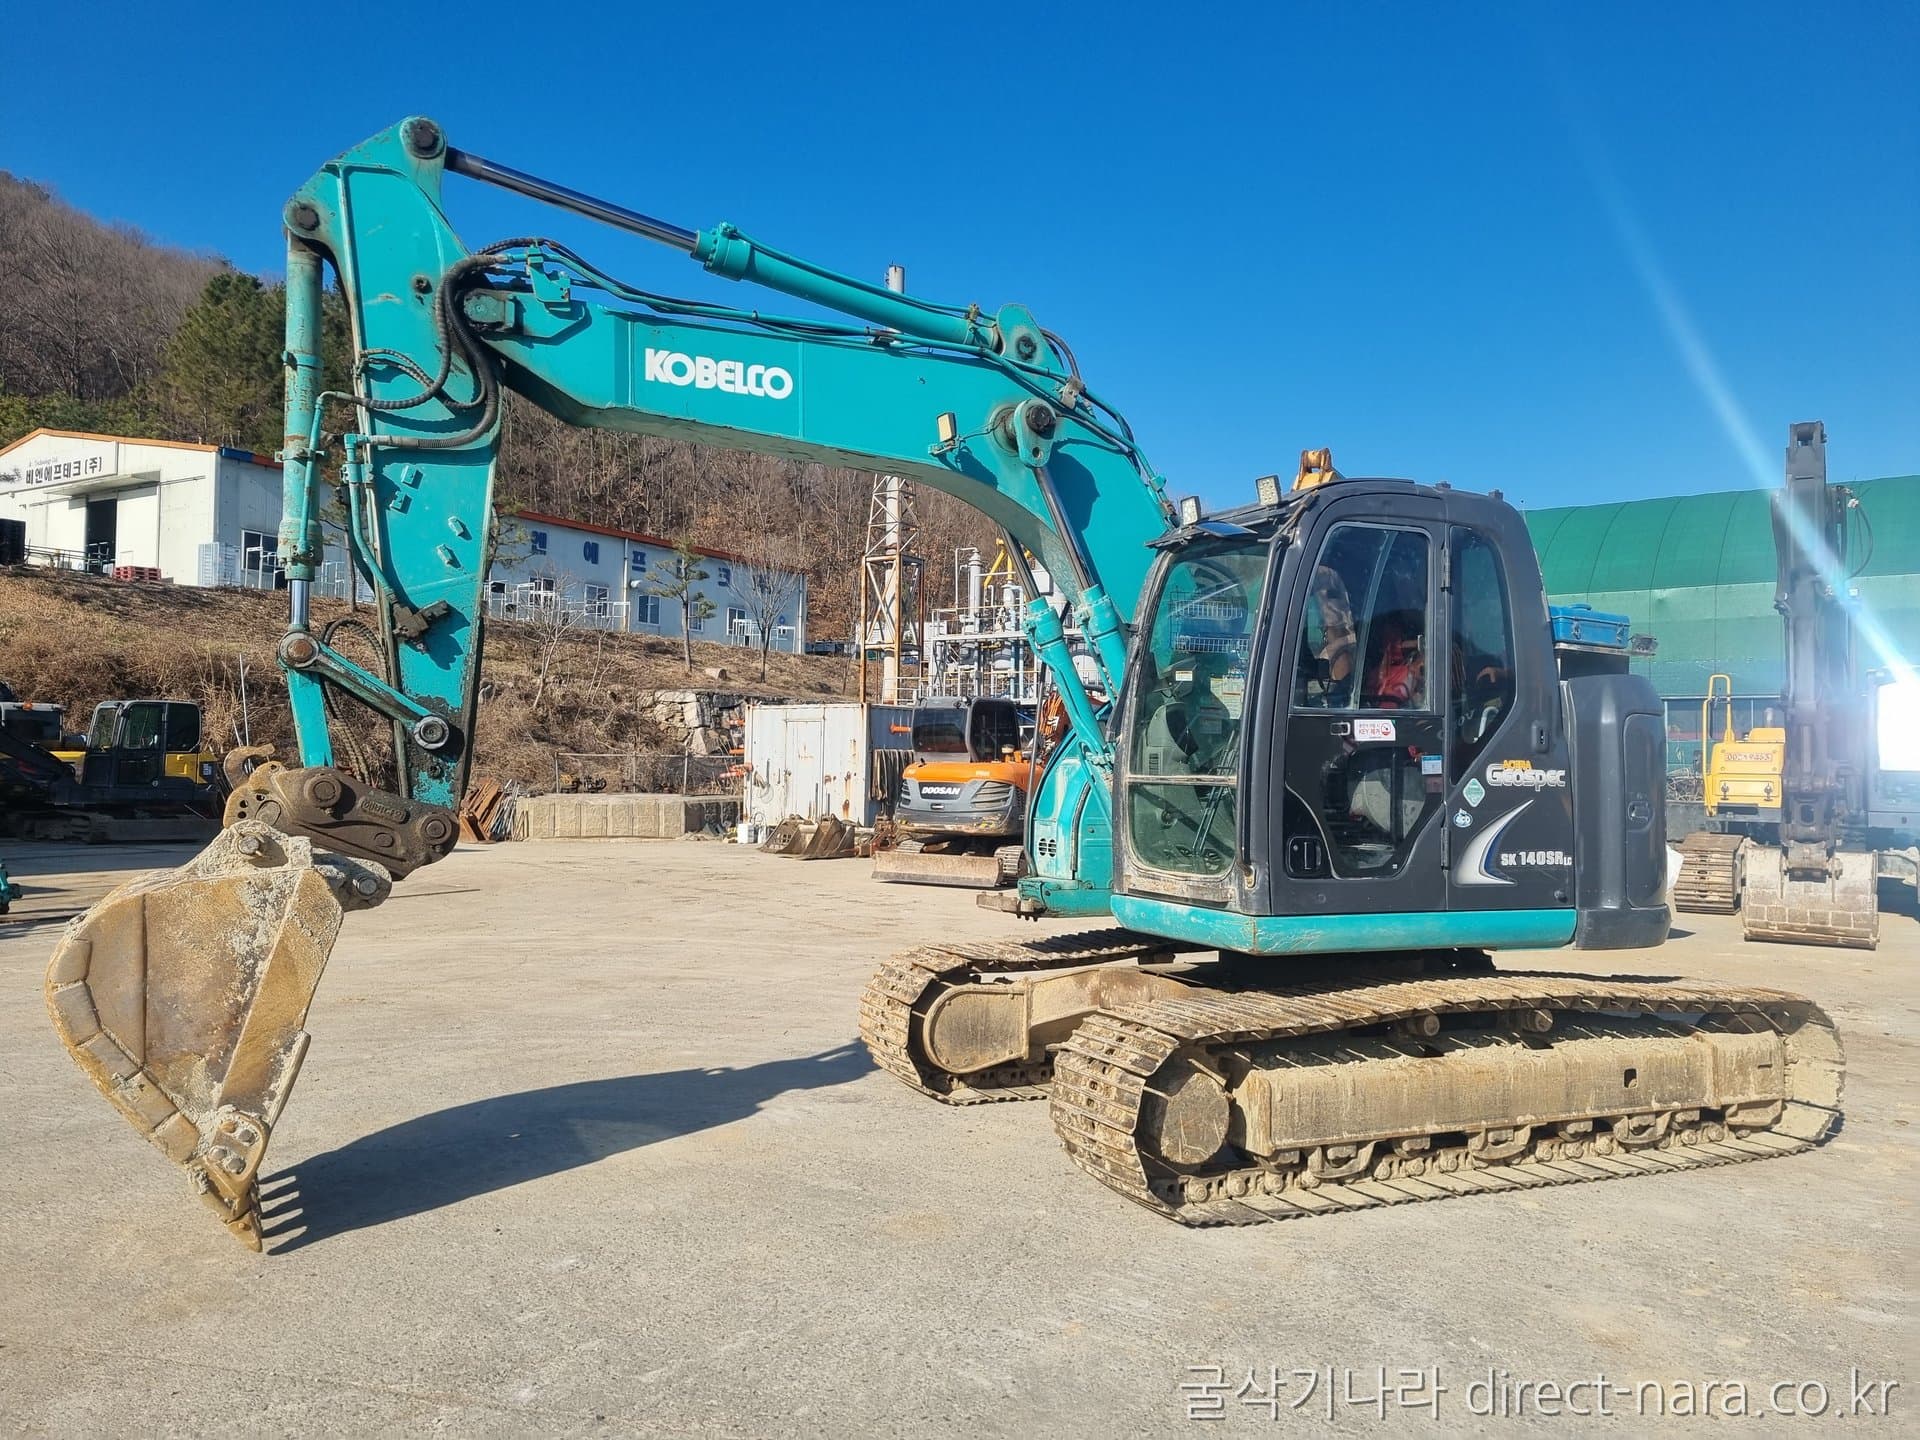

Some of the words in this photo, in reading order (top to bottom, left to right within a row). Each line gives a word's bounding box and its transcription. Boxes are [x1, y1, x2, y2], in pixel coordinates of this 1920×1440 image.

[645, 347, 793, 400] KOBELCO
[1486, 763, 1566, 793] Geospec
[922, 787, 960, 795] DOOSAN
[1501, 853, 1517, 866] SK
